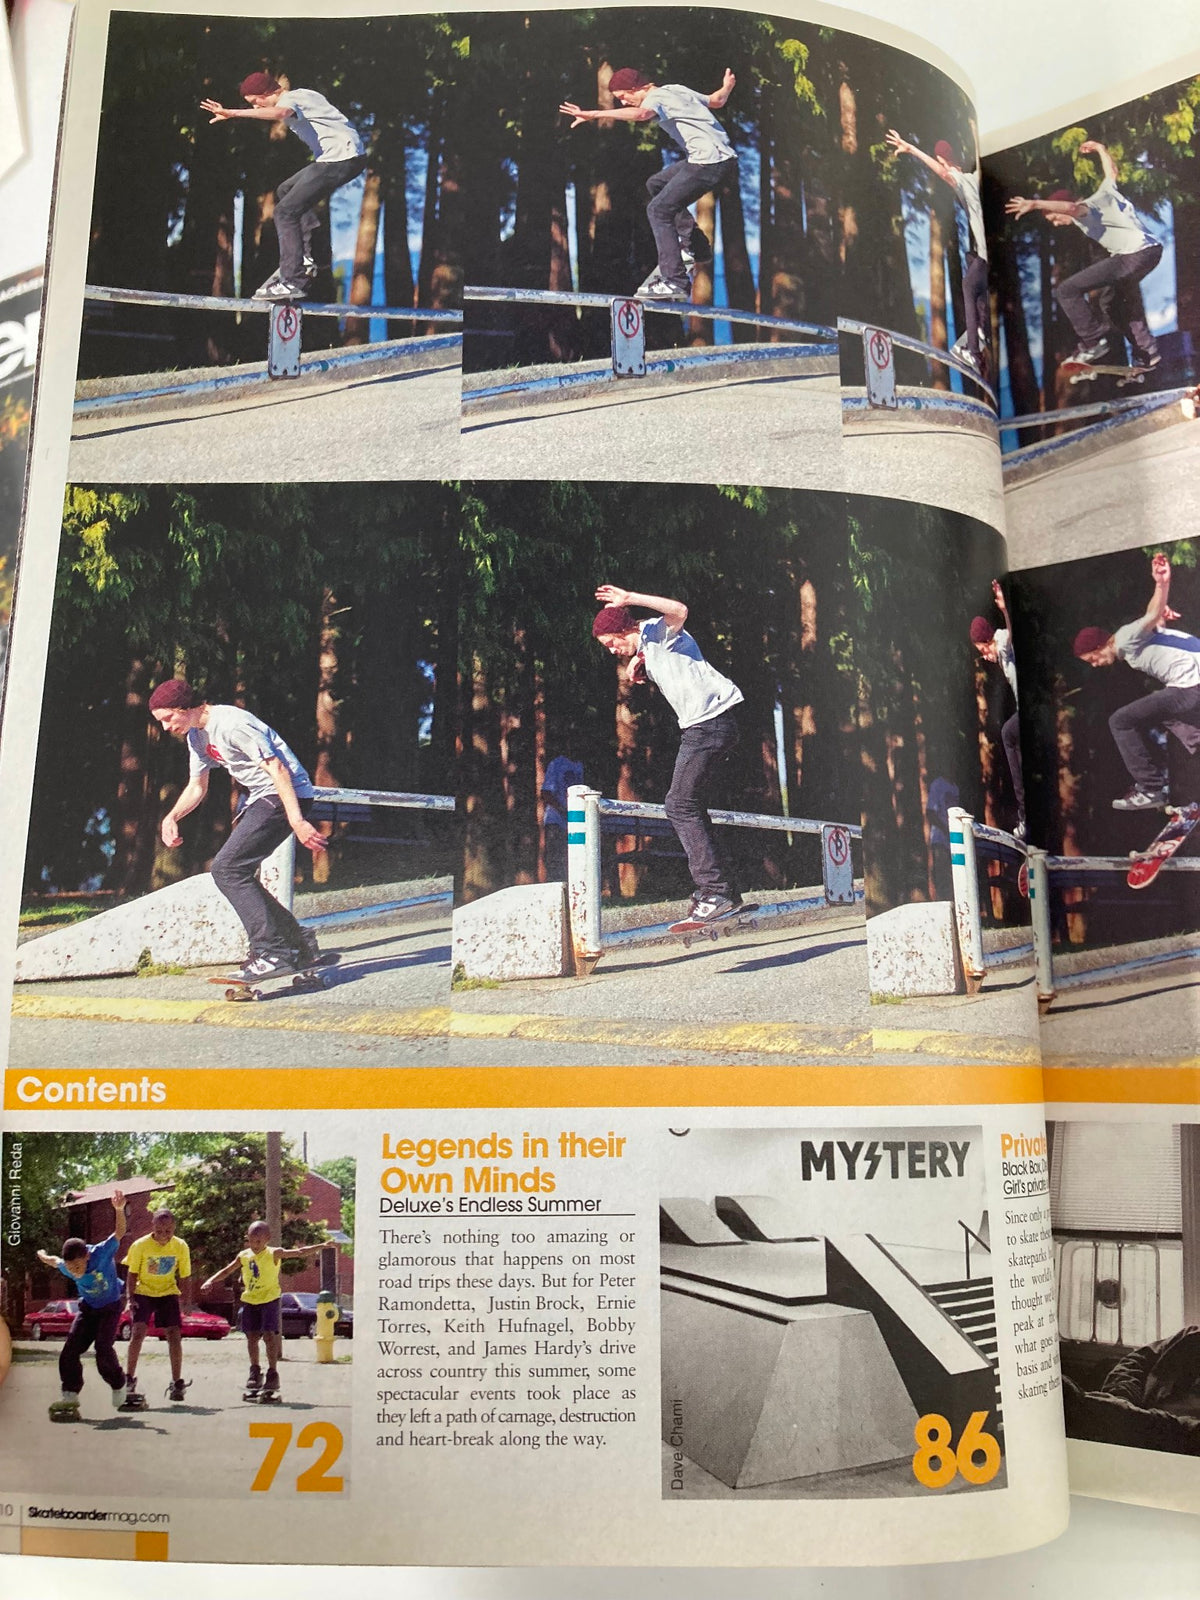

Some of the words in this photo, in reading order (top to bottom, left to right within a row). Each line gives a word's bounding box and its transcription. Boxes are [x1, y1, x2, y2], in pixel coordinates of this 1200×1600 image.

[16, 1076, 167, 1103] Contents
[382, 1132, 513, 1167] Legends
[523, 1132, 549, 1158] in
[559, 1131, 626, 1158] their
[9, 1142, 22, 1180] Reda
[801, 1141, 970, 1181] MYSTERY
[1002, 1160, 1028, 1176] Black
[380, 1166, 454, 1194] Own
[464, 1166, 556, 1193] Minds
[1003, 1180, 1025, 1195] Girl's
[380, 1197, 454, 1213] Deluxe's
[459, 1197, 523, 1213] Endless
[528, 1197, 601, 1212] Summer
[8, 1185, 22, 1246] Giovanni
[1005, 1210, 1028, 1224] Since
[379, 1229, 431, 1245] There's
[443, 1229, 500, 1247] nothing
[511, 1230, 535, 1244] too
[547, 1230, 608, 1246] amazing
[620, 1231, 636, 1242] or
[1007, 1235, 1016, 1245] to
[1020, 1230, 1038, 1244] skate
[378, 1252, 457, 1270] glamorous
[465, 1251, 494, 1266] that
[503, 1251, 564, 1269] happens
[572, 1253, 591, 1265] on
[600, 1252, 636, 1265] most
[378, 1273, 412, 1289] road
[419, 1274, 451, 1291] trips
[457, 1273, 493, 1288] these
[499, 1273, 535, 1291] days.
[542, 1273, 566, 1287] But
[572, 1273, 594, 1287] for
[600, 1273, 636, 1287] Peter
[1010, 1274, 1024, 1288] the
[378, 1296, 475, 1312] Ramondetta,
[486, 1296, 530, 1313] Justin
[536, 1295, 584, 1312] Brock,
[597, 1295, 636, 1309] Ernie
[1012, 1292, 1043, 1310] thought
[378, 1319, 431, 1336] Torres,
[444, 1318, 485, 1333] Keith
[498, 1318, 574, 1336] Hufnagel,
[587, 1317, 636, 1335] Bobby
[1013, 1315, 1034, 1336] peak
[1037, 1316, 1044, 1328] at
[377, 1341, 440, 1358] Worrest,
[448, 1341, 475, 1355] and
[482, 1341, 527, 1358] James
[534, 1340, 592, 1358] Hardy's
[599, 1340, 636, 1355] drive
[1015, 1338, 1037, 1354] what
[377, 1366, 422, 1378] across
[430, 1365, 487, 1381] country
[495, 1363, 521, 1377] this
[528, 1366, 590, 1380] summer,
[598, 1365, 636, 1376] some
[1016, 1360, 1038, 1377] basis
[1040, 1354, 1052, 1372] and
[377, 1386, 459, 1404] spectacular
[470, 1388, 516, 1400] events
[528, 1385, 561, 1400] took
[573, 1385, 610, 1404] place
[621, 1388, 636, 1400] as
[1018, 1381, 1048, 1400] skating
[377, 1408, 406, 1427] they
[410, 1408, 431, 1423] left
[434, 1412, 442, 1423] a
[446, 1408, 477, 1427] path
[481, 1408, 496, 1423] of
[498, 1411, 556, 1427] carnage,
[559, 1407, 636, 1422] destruction
[670, 1399, 683, 1446] Chami
[376, 1431, 404, 1446] and
[409, 1431, 494, 1446] heart-break
[500, 1431, 540, 1449] along
[546, 1431, 568, 1446] the
[573, 1433, 607, 1449] way.
[913, 1411, 1001, 1488] 86
[248, 1422, 344, 1493] 72
[671, 1453, 683, 1490] Dave
[28, 1506, 170, 1525] Skateboardermag.com
